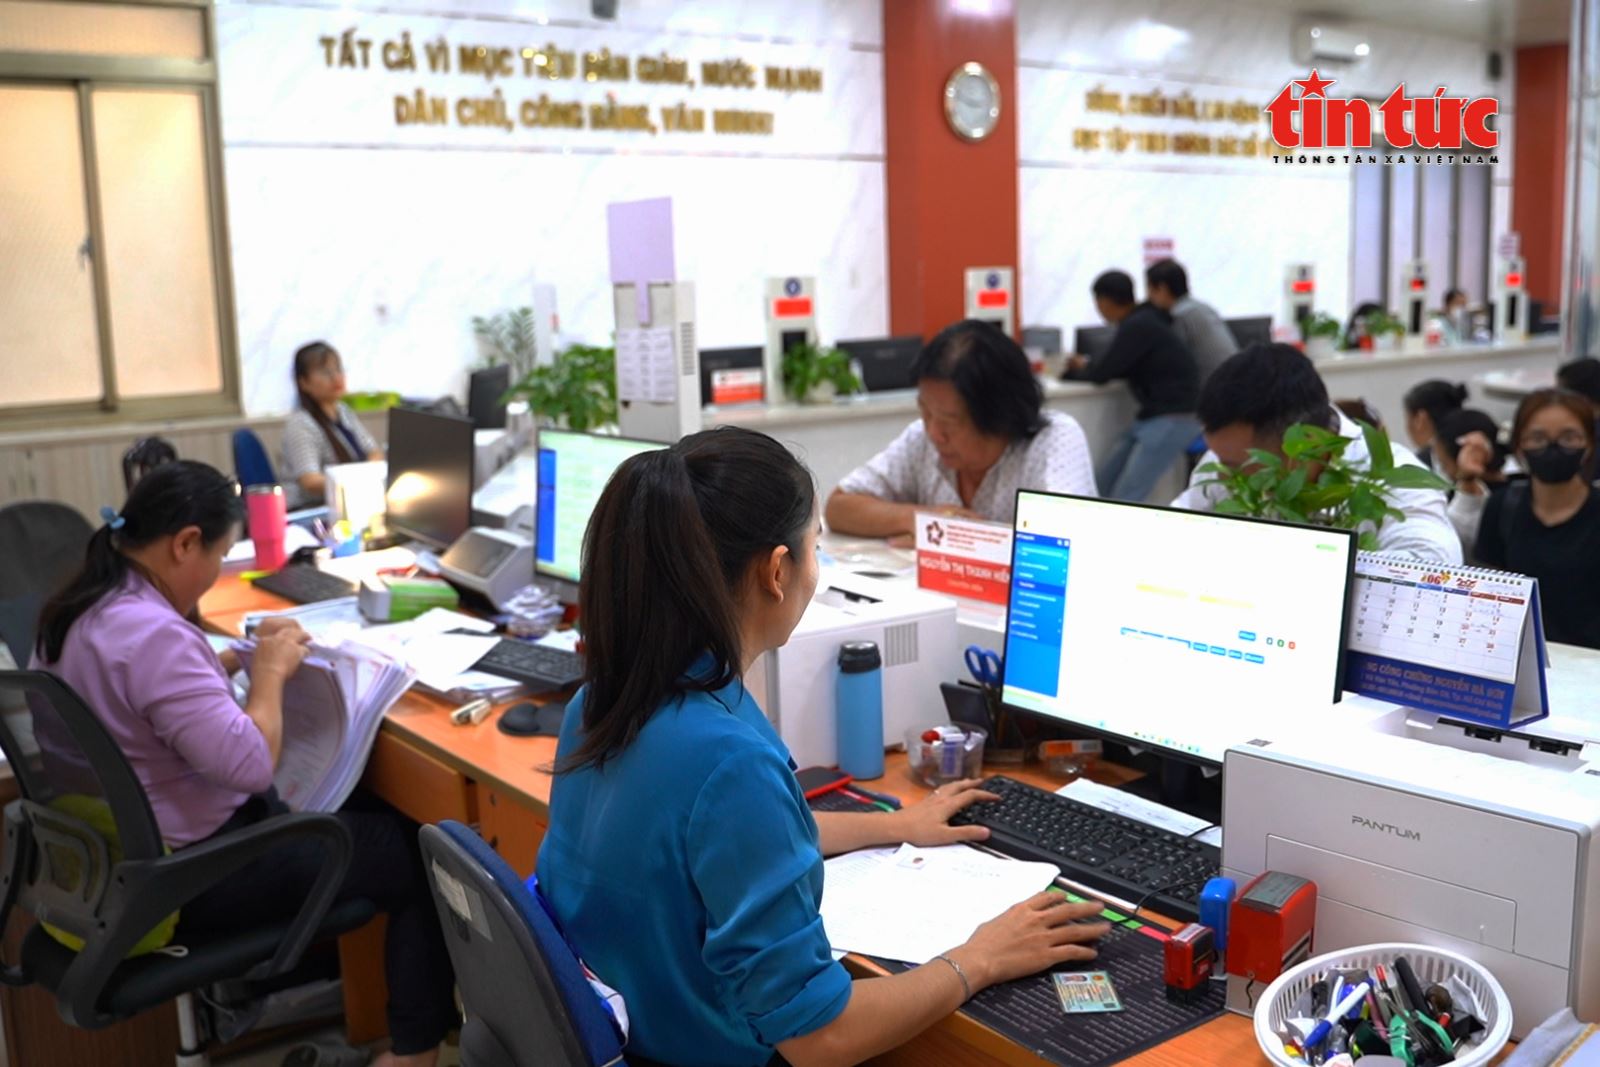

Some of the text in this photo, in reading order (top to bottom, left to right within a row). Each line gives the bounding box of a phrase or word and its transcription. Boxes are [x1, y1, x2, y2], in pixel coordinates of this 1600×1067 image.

[320, 29, 372, 68] TẤT
[382, 32, 416, 71] CẢ
[394, 88, 448, 125] DÂN
[1351, 815, 1420, 841] PANTUM
